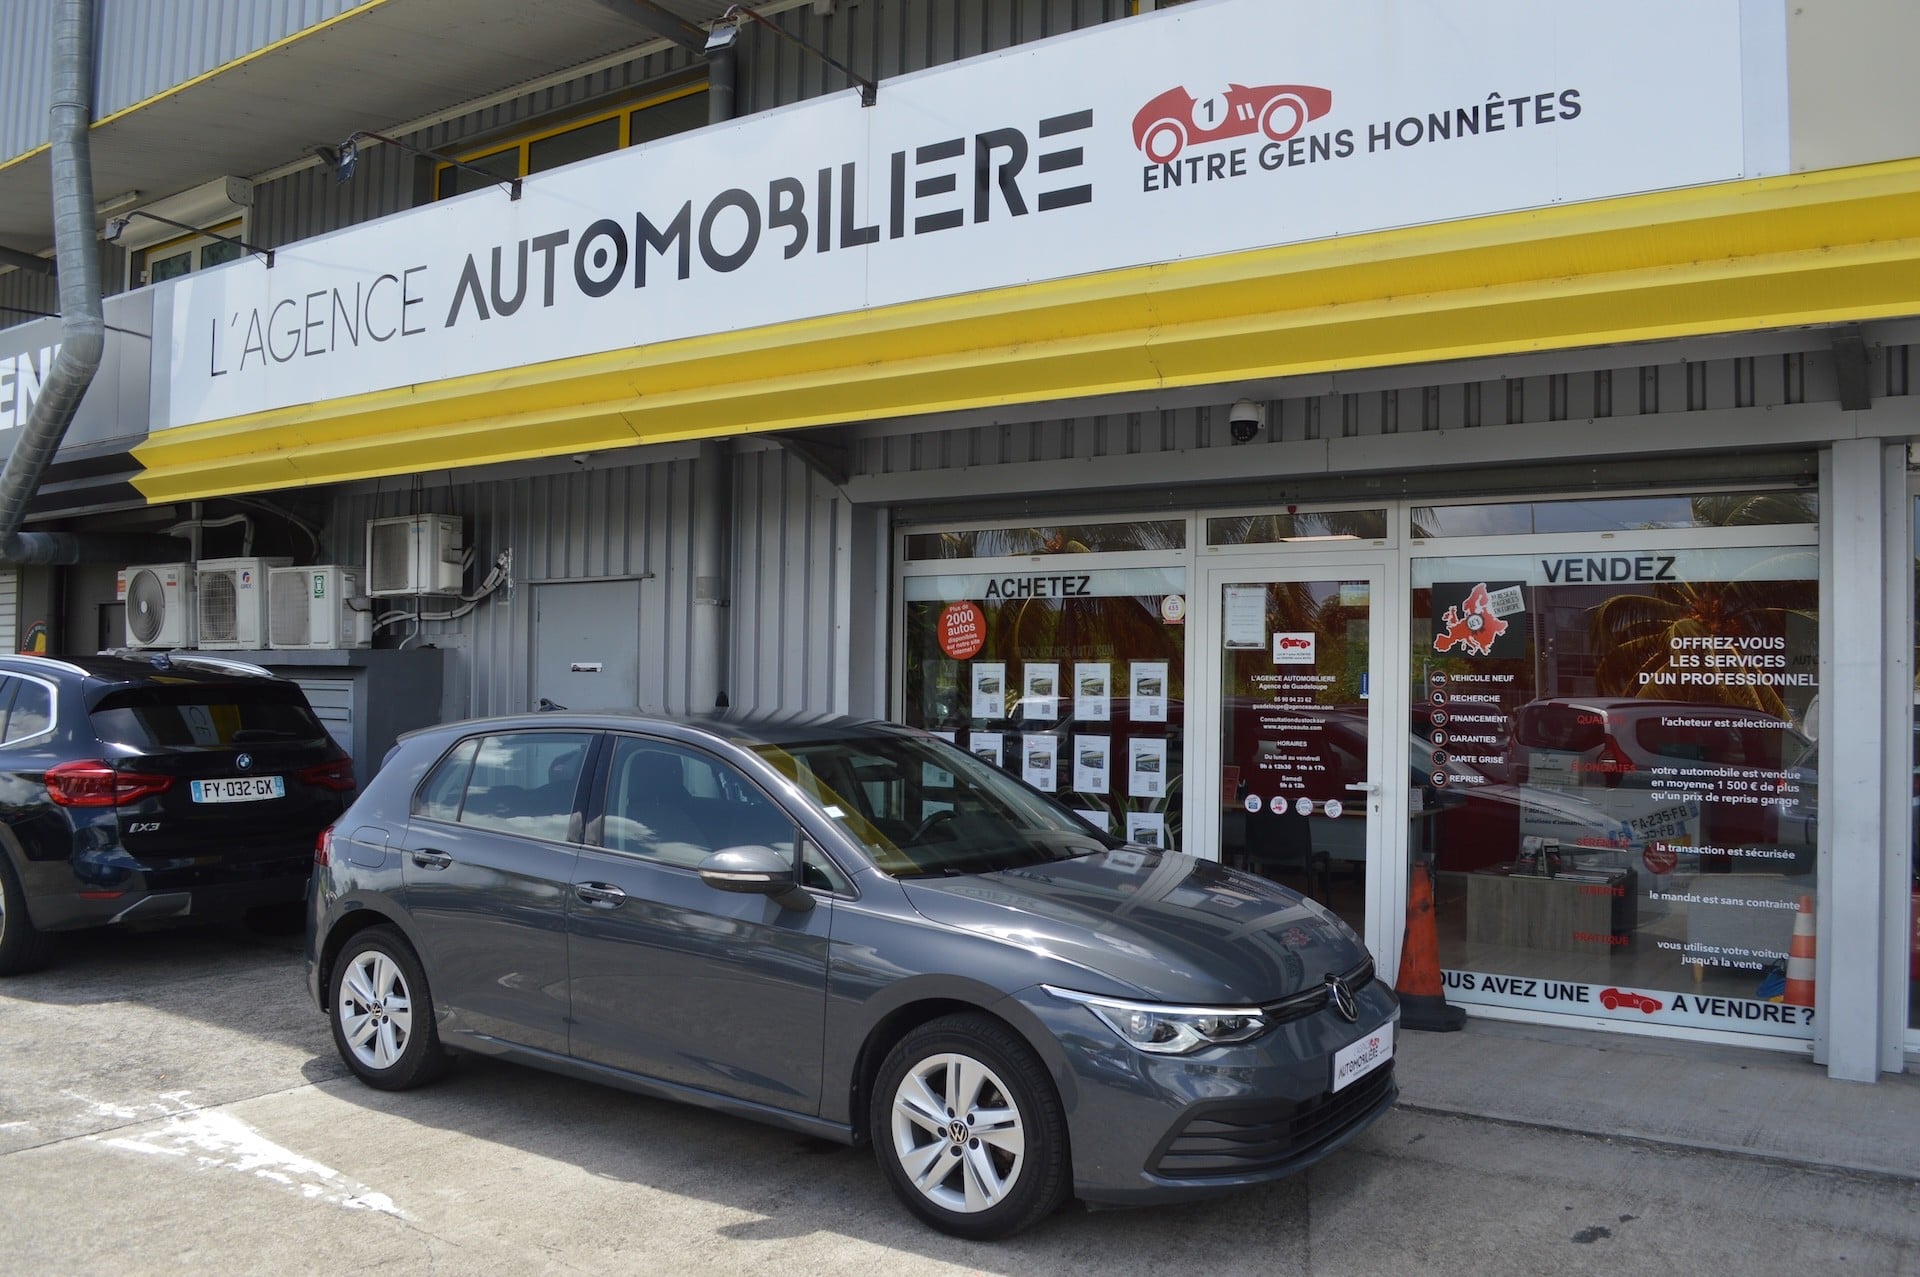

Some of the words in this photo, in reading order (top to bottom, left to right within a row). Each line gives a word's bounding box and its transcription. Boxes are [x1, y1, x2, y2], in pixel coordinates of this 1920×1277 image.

[1202, 98, 1215, 123] 1
[1143, 148, 1247, 192] ENTRE
[1258, 129, 1354, 171] GENS
[1369, 88, 1582, 153] HONNÊTES
[211, 265, 427, 378] L'AGENCE
[445, 108, 1093, 328] AUTOMOBILIERE
[0, 344, 62, 430] EN
[1542, 556, 1678, 583] VENDEZ
[985, 574, 1091, 598] ACHETEZ
[946, 610, 974, 627] 2000
[947, 622, 976, 637] autos
[947, 633, 978, 644] disponibles
[956, 641, 971, 649] notre
[970, 638, 981, 646] site
[1670, 636, 1785, 650] OFFREZ-VOUS
[952, 646, 973, 656] internet
[1670, 655, 1700, 668] LES
[1704, 655, 1786, 668] SERVICES
[1492, 674, 1514, 682] NEUF
[1638, 672, 1677, 685] D'UN
[1680, 672, 1819, 687] PROFESSIONNEL
[1259, 683, 1281, 691] Agence
[1291, 683, 1328, 691] Guadeloupe
[1450, 694, 1501, 702] RECHERCHE
[1450, 714, 1508, 723] FINANCEMENT
[1662, 717, 1712, 728] l'acheteur
[1714, 718, 1730, 728] est
[1732, 718, 1793, 729] sélectionné
[1450, 734, 1496, 743] GARANTIES
[1450, 754, 1476, 763] CARTE
[1478, 756, 1504, 764] GRISE
[1450, 775, 1484, 783] REPRISE
[1651, 767, 1678, 776] votre
[1680, 767, 1740, 778] automobile
[1742, 769, 1758, 778] est
[1760, 770, 1800, 780] vendue
[1666, 781, 1714, 790] moyenne
[1718, 780, 1723, 790] 1
[1726, 781, 1748, 790] 500
[1750, 782, 1758, 791] €
[1760, 782, 1774, 792] de
[1776, 782, 1800, 794] plus
[1651, 792, 1680, 802] qu'un
[1683, 792, 1703, 803] prix
[1705, 793, 1720, 802] de
[1722, 794, 1758, 806] reprise
[1760, 797, 1800, 808] garage
[1656, 842, 1666, 852] la
[1668, 844, 1725, 855] transaction
[1727, 848, 1744, 856] est
[1746, 848, 1796, 859] sécurisée
[1650, 890, 1660, 900] le
[1662, 892, 1702, 903] mandat
[1702, 896, 1719, 904] est
[1720, 896, 1744, 906] sans
[1746, 898, 1800, 910] contrainte
[1657, 940, 1682, 950] vous
[1684, 942, 1720, 954] utilisez
[1722, 946, 1750, 956] votre
[1752, 947, 1790, 960] voiture
[1681, 954, 1718, 966] jusqu'à
[1721, 956, 1730, 967] la
[1732, 959, 1763, 970] vente
[1482, 976, 1538, 998] AVEZ
[1544, 983, 1590, 1003] UNE
[1672, 995, 1688, 1013] A
[1694, 996, 1796, 1024] VENDRE
